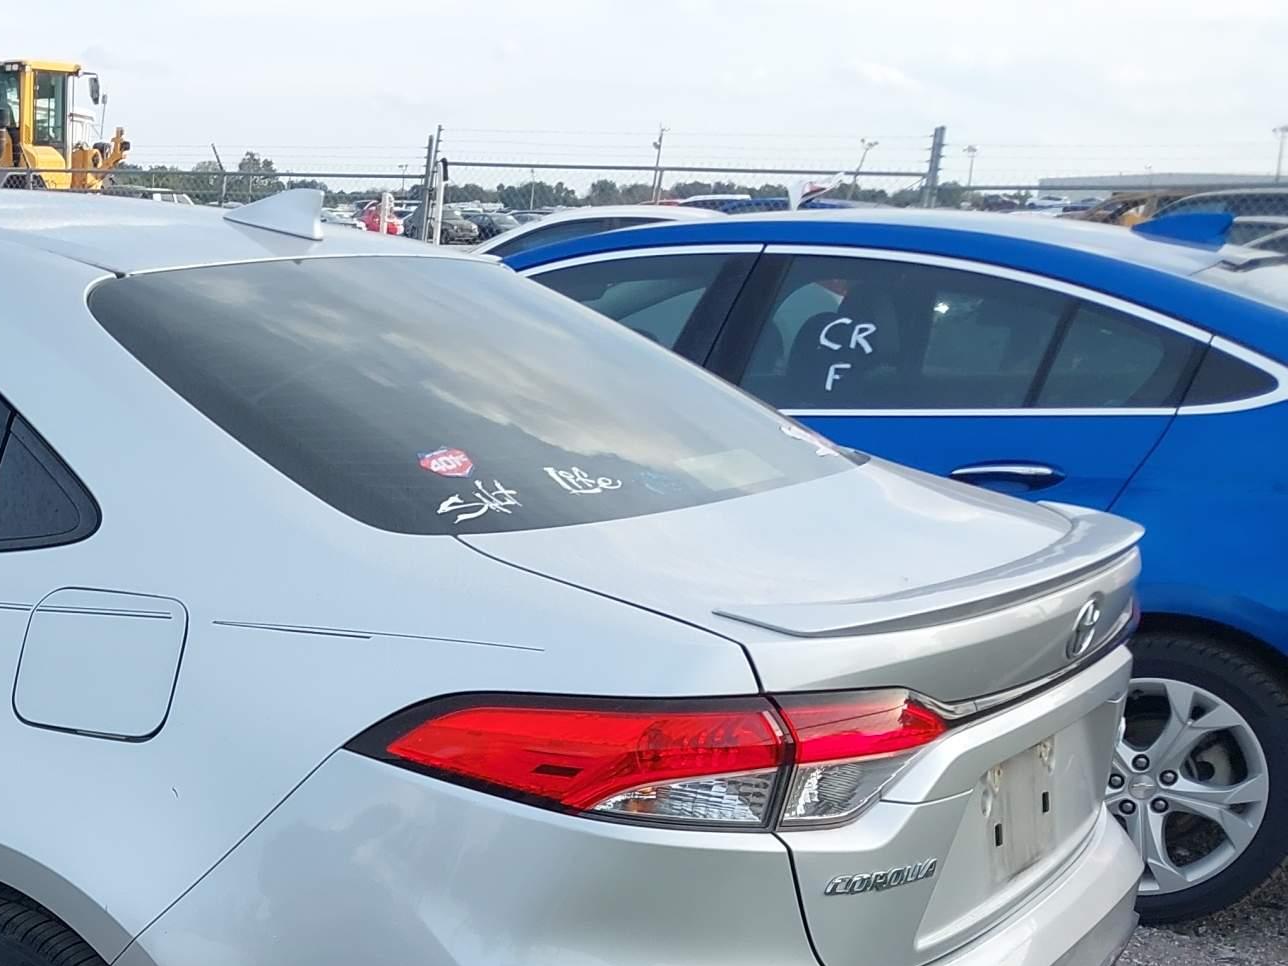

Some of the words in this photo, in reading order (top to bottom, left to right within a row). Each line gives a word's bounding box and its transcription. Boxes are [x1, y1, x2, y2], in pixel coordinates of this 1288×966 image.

[819, 317, 877, 354] CR
[825, 363, 852, 391] F
[824, 858, 938, 896] COROLLA
